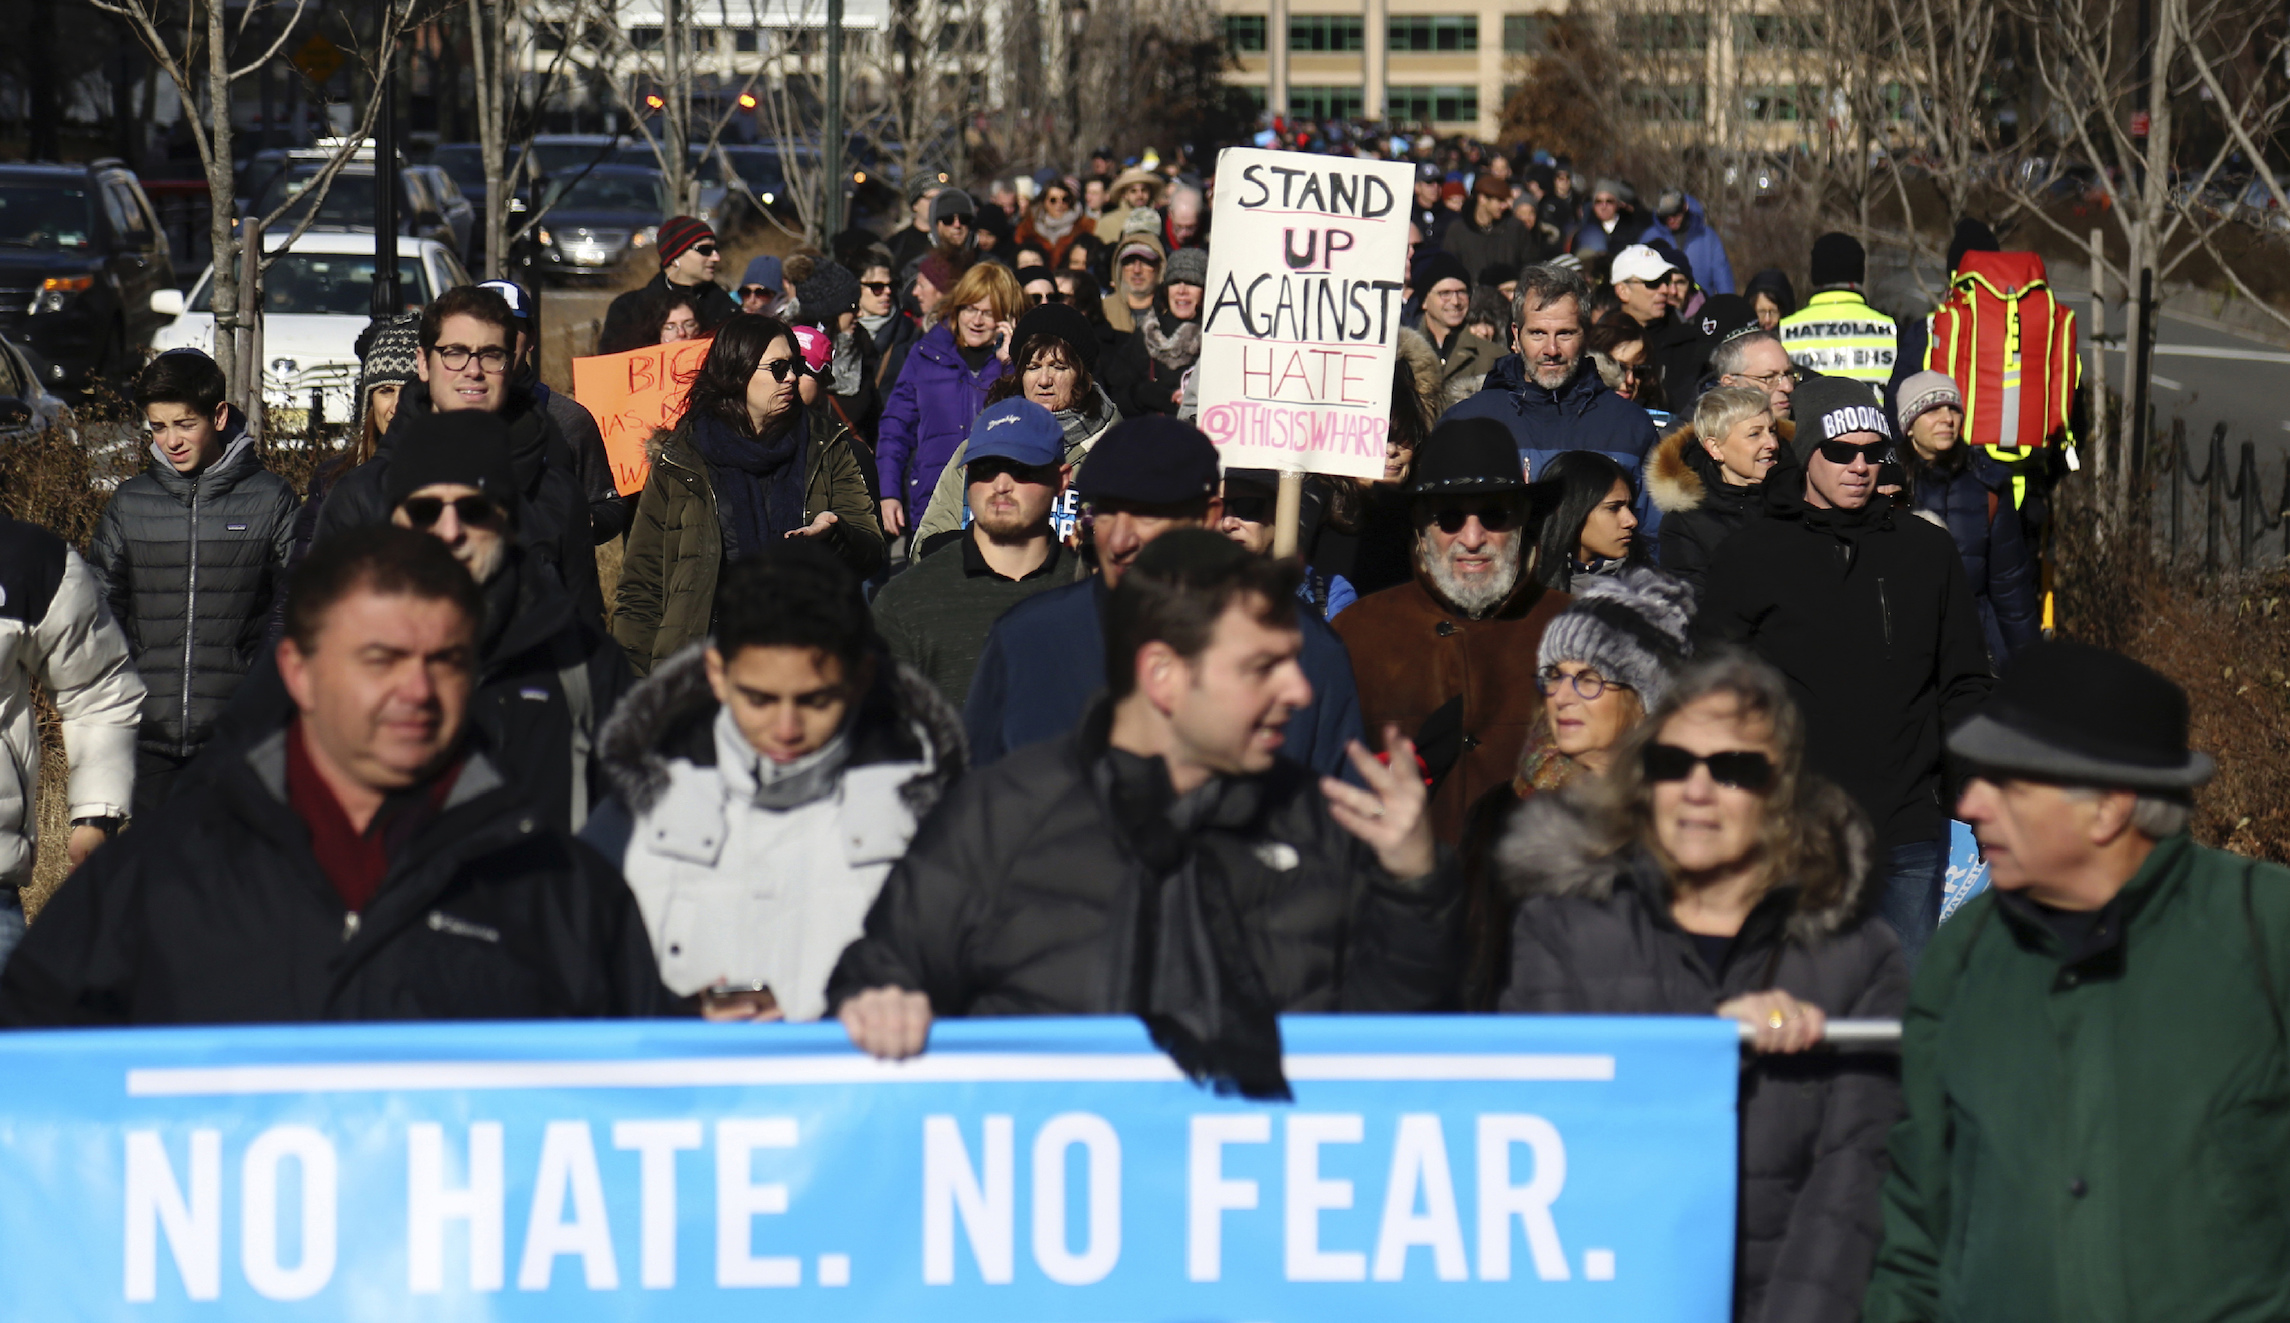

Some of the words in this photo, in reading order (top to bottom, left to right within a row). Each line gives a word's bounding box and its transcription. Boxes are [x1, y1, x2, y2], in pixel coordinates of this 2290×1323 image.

[1238, 164, 1394, 218] STAND
[1283, 227, 1354, 270] UP
[1204, 271, 1403, 344] AGAINST
[1786, 321, 1892, 338] HATZOLAH
[1200, 401, 1389, 458] @THISISWHARR
[124, 1126, 337, 1301] NO
[408, 1119, 850, 1293] HATE.
[923, 1112, 1122, 1285] NO
[1188, 1113, 1616, 1281] FEAR.
